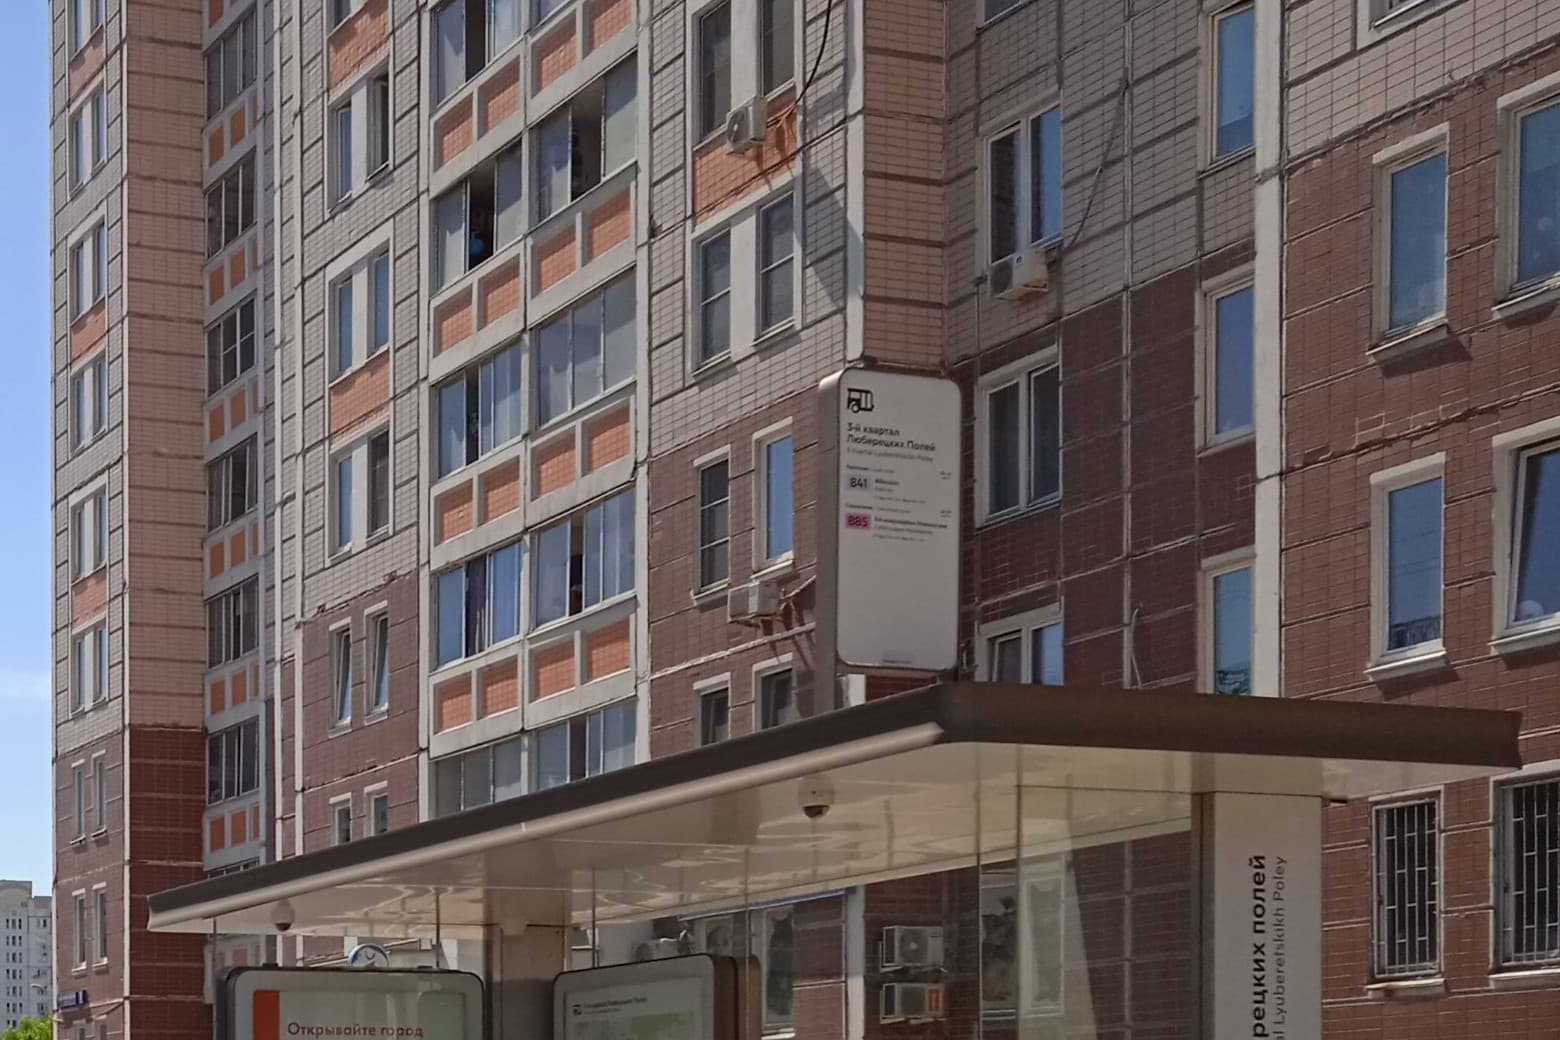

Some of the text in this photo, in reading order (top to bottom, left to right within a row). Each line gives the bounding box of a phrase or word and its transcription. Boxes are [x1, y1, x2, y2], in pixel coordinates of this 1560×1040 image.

[849, 477, 868, 489] 841
[847, 515, 869, 528] 885
[1248, 855, 1267, 934] полей
[1273, 856, 1287, 902] Poley
[1273, 907, 1287, 1025] Lyuberetskikh
[287, 1022, 424, 1040] Открывайте город
